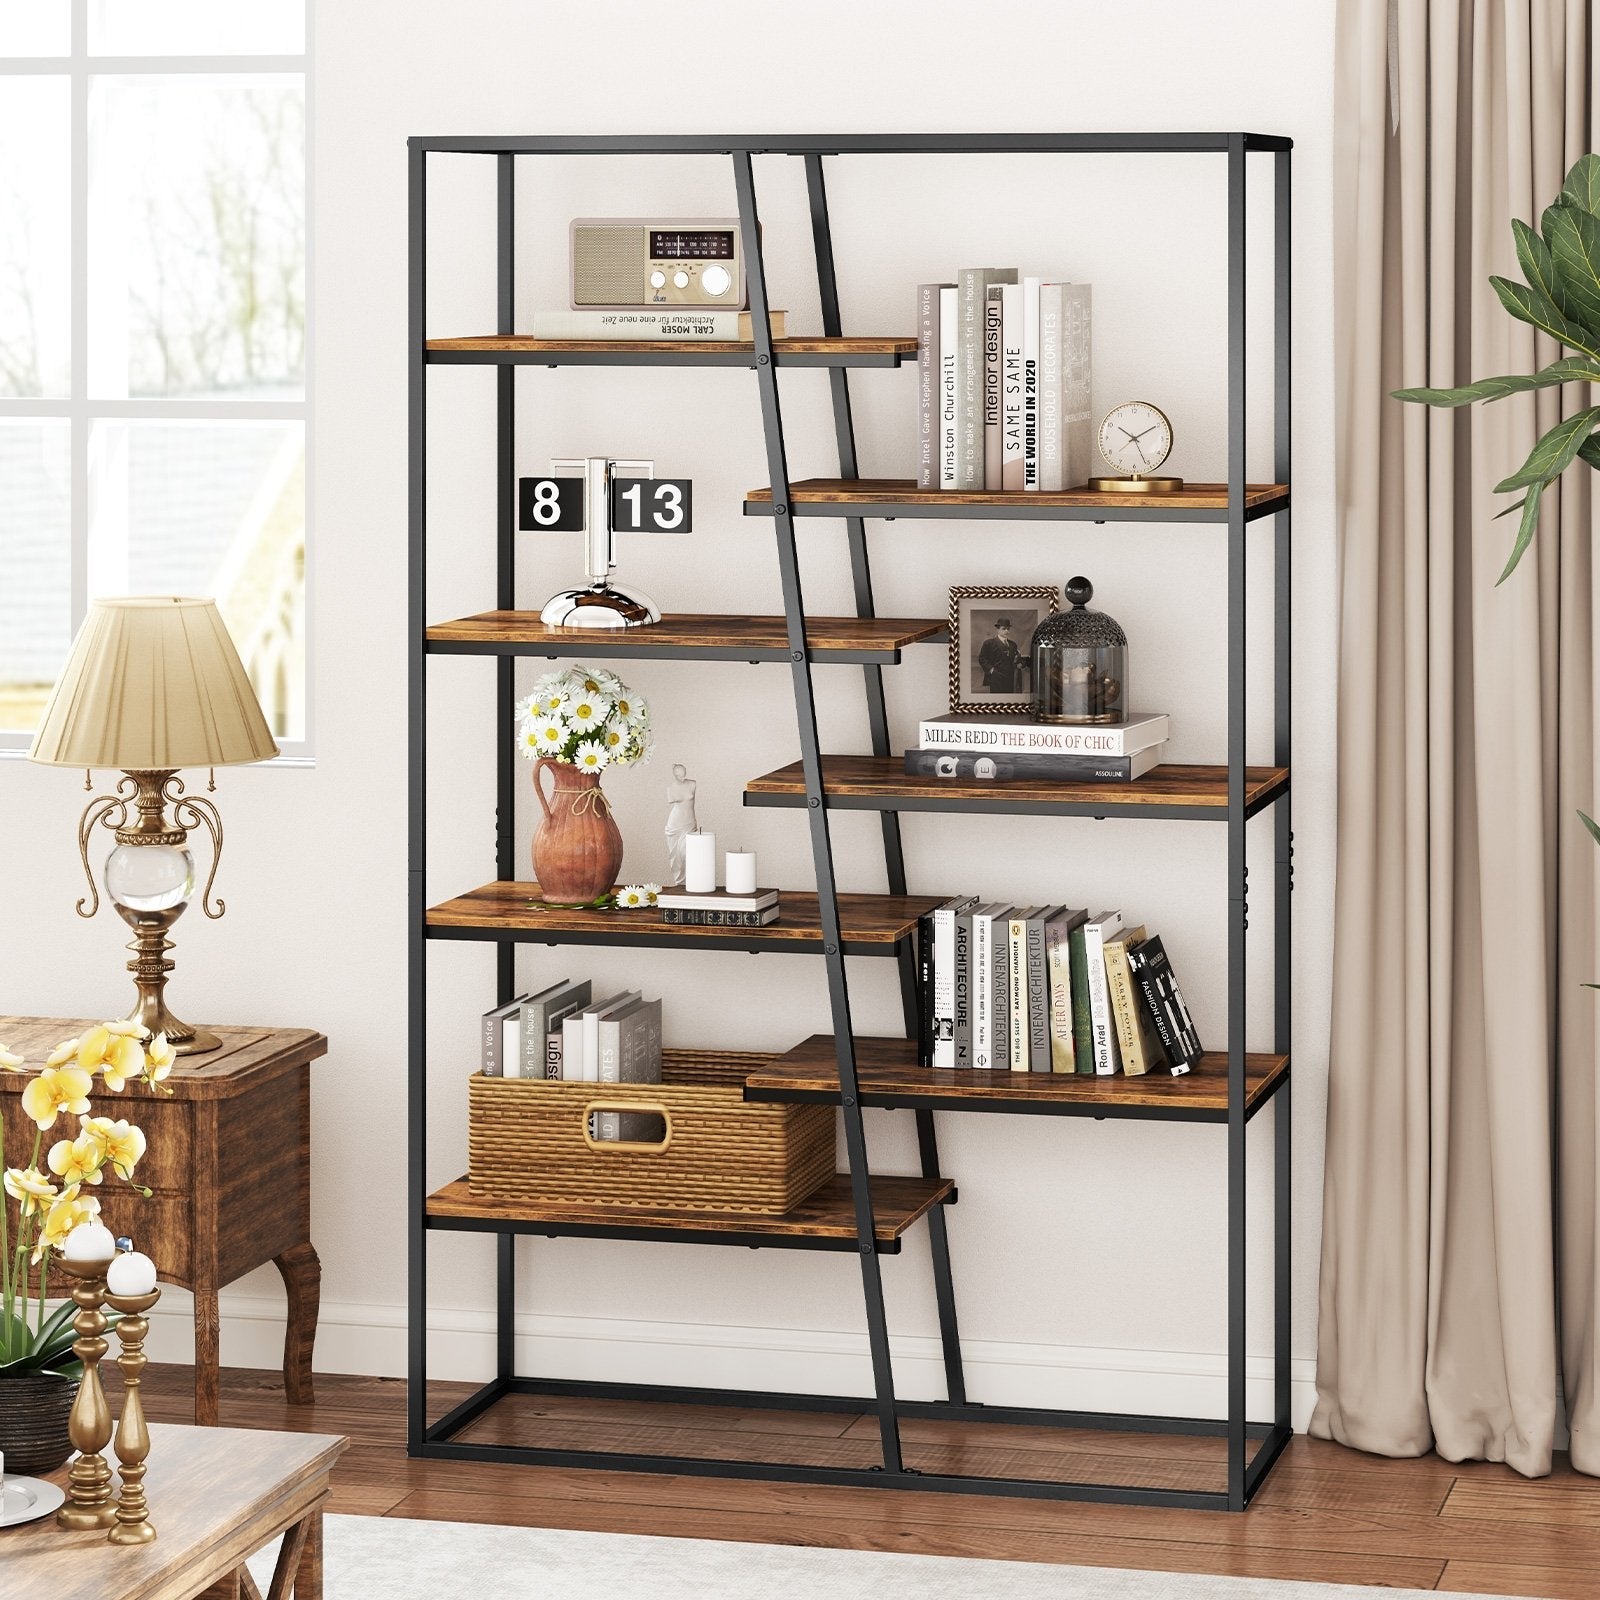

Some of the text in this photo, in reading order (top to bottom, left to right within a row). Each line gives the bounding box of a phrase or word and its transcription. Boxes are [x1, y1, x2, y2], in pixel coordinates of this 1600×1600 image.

[602, 316, 617, 325] Zeit
[640, 316, 656, 324] eine
[658, 316, 670, 324] für
[672, 316, 714, 325] Architektur
[922, 289, 930, 316] Voice
[693, 325, 714, 334] CARL
[923, 330, 932, 367] Hawking
[923, 372, 931, 408] Stephen
[965, 274, 976, 482] How to make an arrangement in the house
[986, 307, 1001, 425] Interior design
[1045, 313, 1056, 460] HOUSEHOLD DECORATES
[944, 355, 954, 480] Winston Churchill
[1007, 348, 1020, 450] SAME SAME
[1026, 360, 1035, 485] THE WORLD IN 2020
[922, 439, 930, 464] Intel
[533, 480, 561, 525] 8
[622, 484, 684, 529] 13
[925, 729, 961, 743] MILES
[965, 731, 997, 744] REDD
[1001, 732, 1025, 746] THE
[1029, 734, 1062, 748] BOOK
[1065, 735, 1081, 748] OF
[1085, 736, 1114, 749] CHIC
[958, 926, 967, 1027] ARCHITECTURE
[995, 944, 1006, 1059] INNENARCHITEKTUR
[1029, 929, 1044, 1049] INNENARCHITEKTUR
[1054, 984, 1067, 1040] AFTER DAYS
[1117, 973, 1127, 1008] HARRY
[1124, 1013, 1134, 1047] POTTER
[1142, 981, 1159, 1016] FASHION
[1156, 1016, 1171, 1046] DESIGN
[526, 1008, 534, 1070] in the house
[1097, 1025, 1106, 1046] Arad
